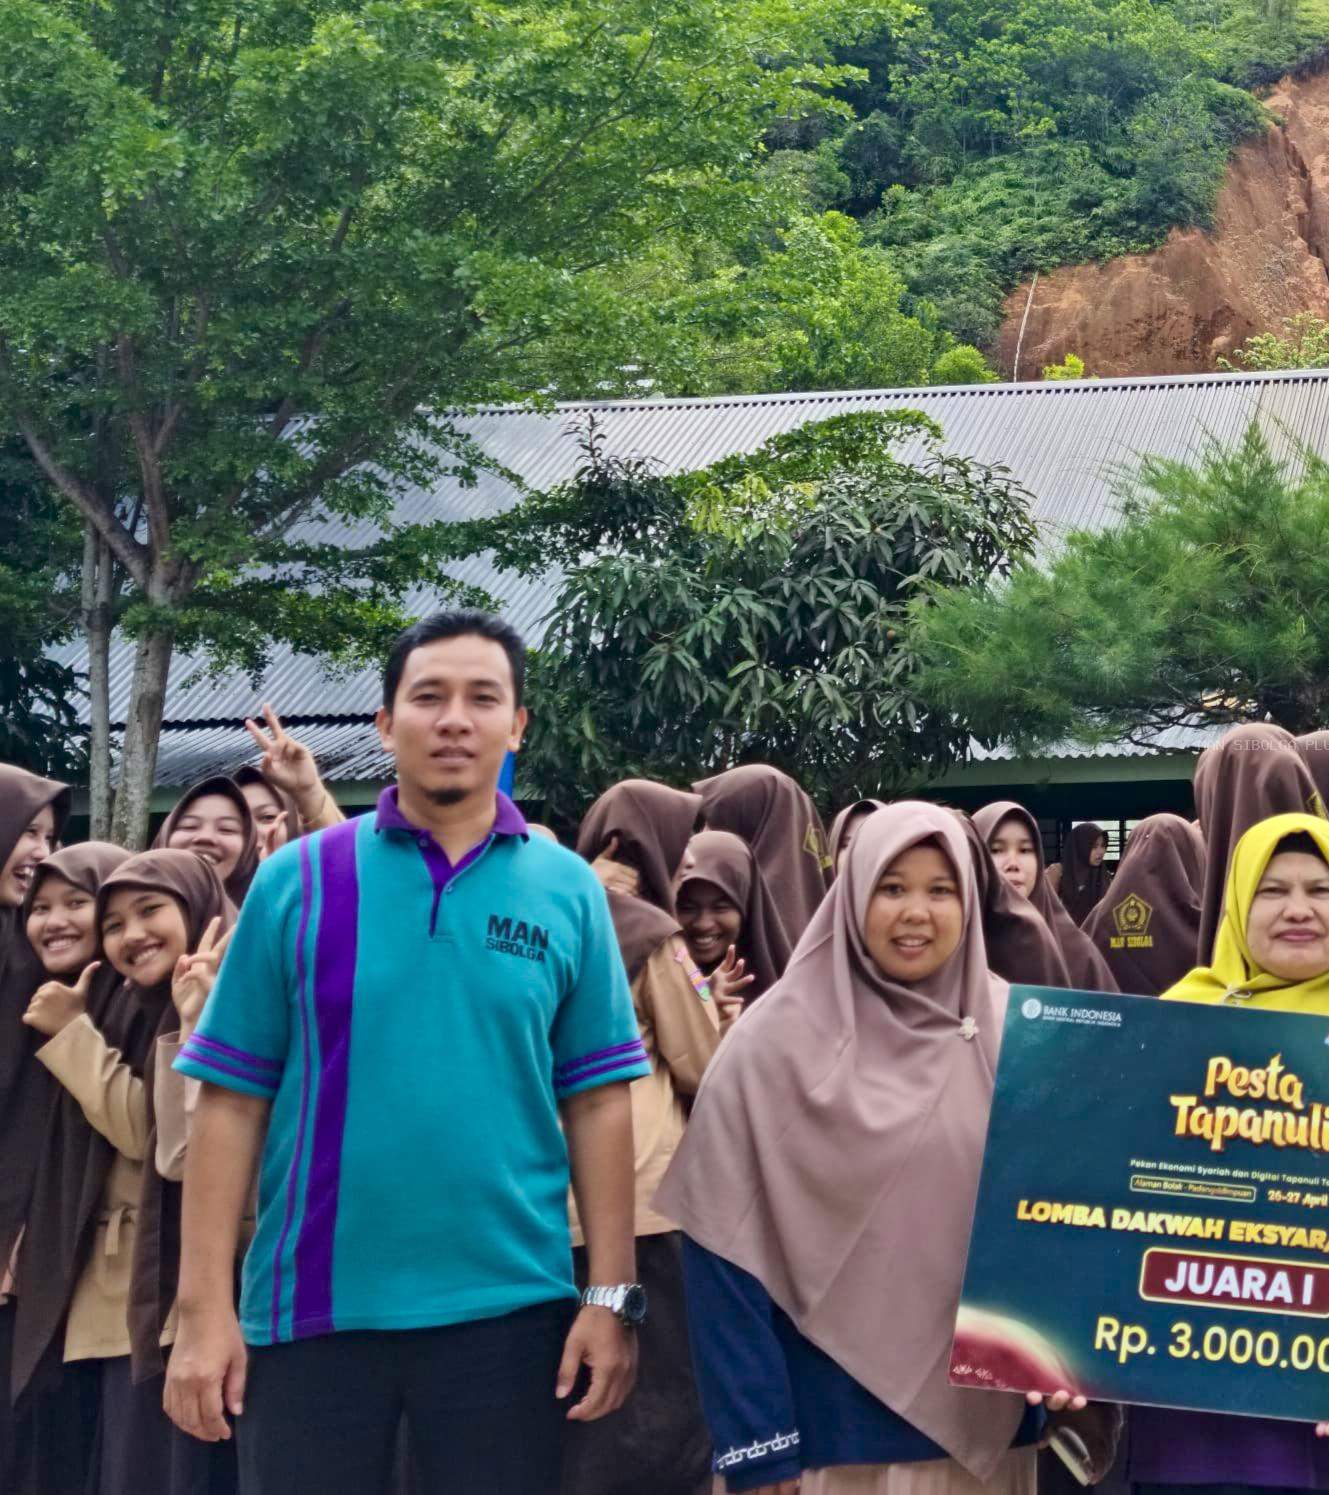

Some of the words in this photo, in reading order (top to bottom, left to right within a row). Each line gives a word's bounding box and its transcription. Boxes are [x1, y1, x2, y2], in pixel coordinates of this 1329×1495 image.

[486, 937, 546, 963] SIBOLGA
[487, 914, 549, 950] MAN
[1043, 1005, 1069, 1017] BANK
[1070, 1008, 1122, 1022] INDONESIA
[1204, 1051, 1305, 1110] Pesta
[1130, 1159, 1157, 1169] Pekan
[1158, 1161, 1196, 1173] Ekonomi
[1197, 1166, 1230, 1177] Syariah
[1232, 1169, 1249, 1178] dan
[1251, 1171, 1280, 1182] Digital
[1281, 1174, 1320, 1186] Tapanuli
[1268, 1189, 1301, 1203] 26-27
[1302, 1192, 1329, 1208] April
[1016, 1199, 1107, 1229] LOMBA
[1111, 1208, 1225, 1240] DAKWAH
[1164, 1260, 1294, 1304] JUARA
[1302, 1273, 1315, 1306] I
[1094, 1315, 1156, 1364] Rp.
